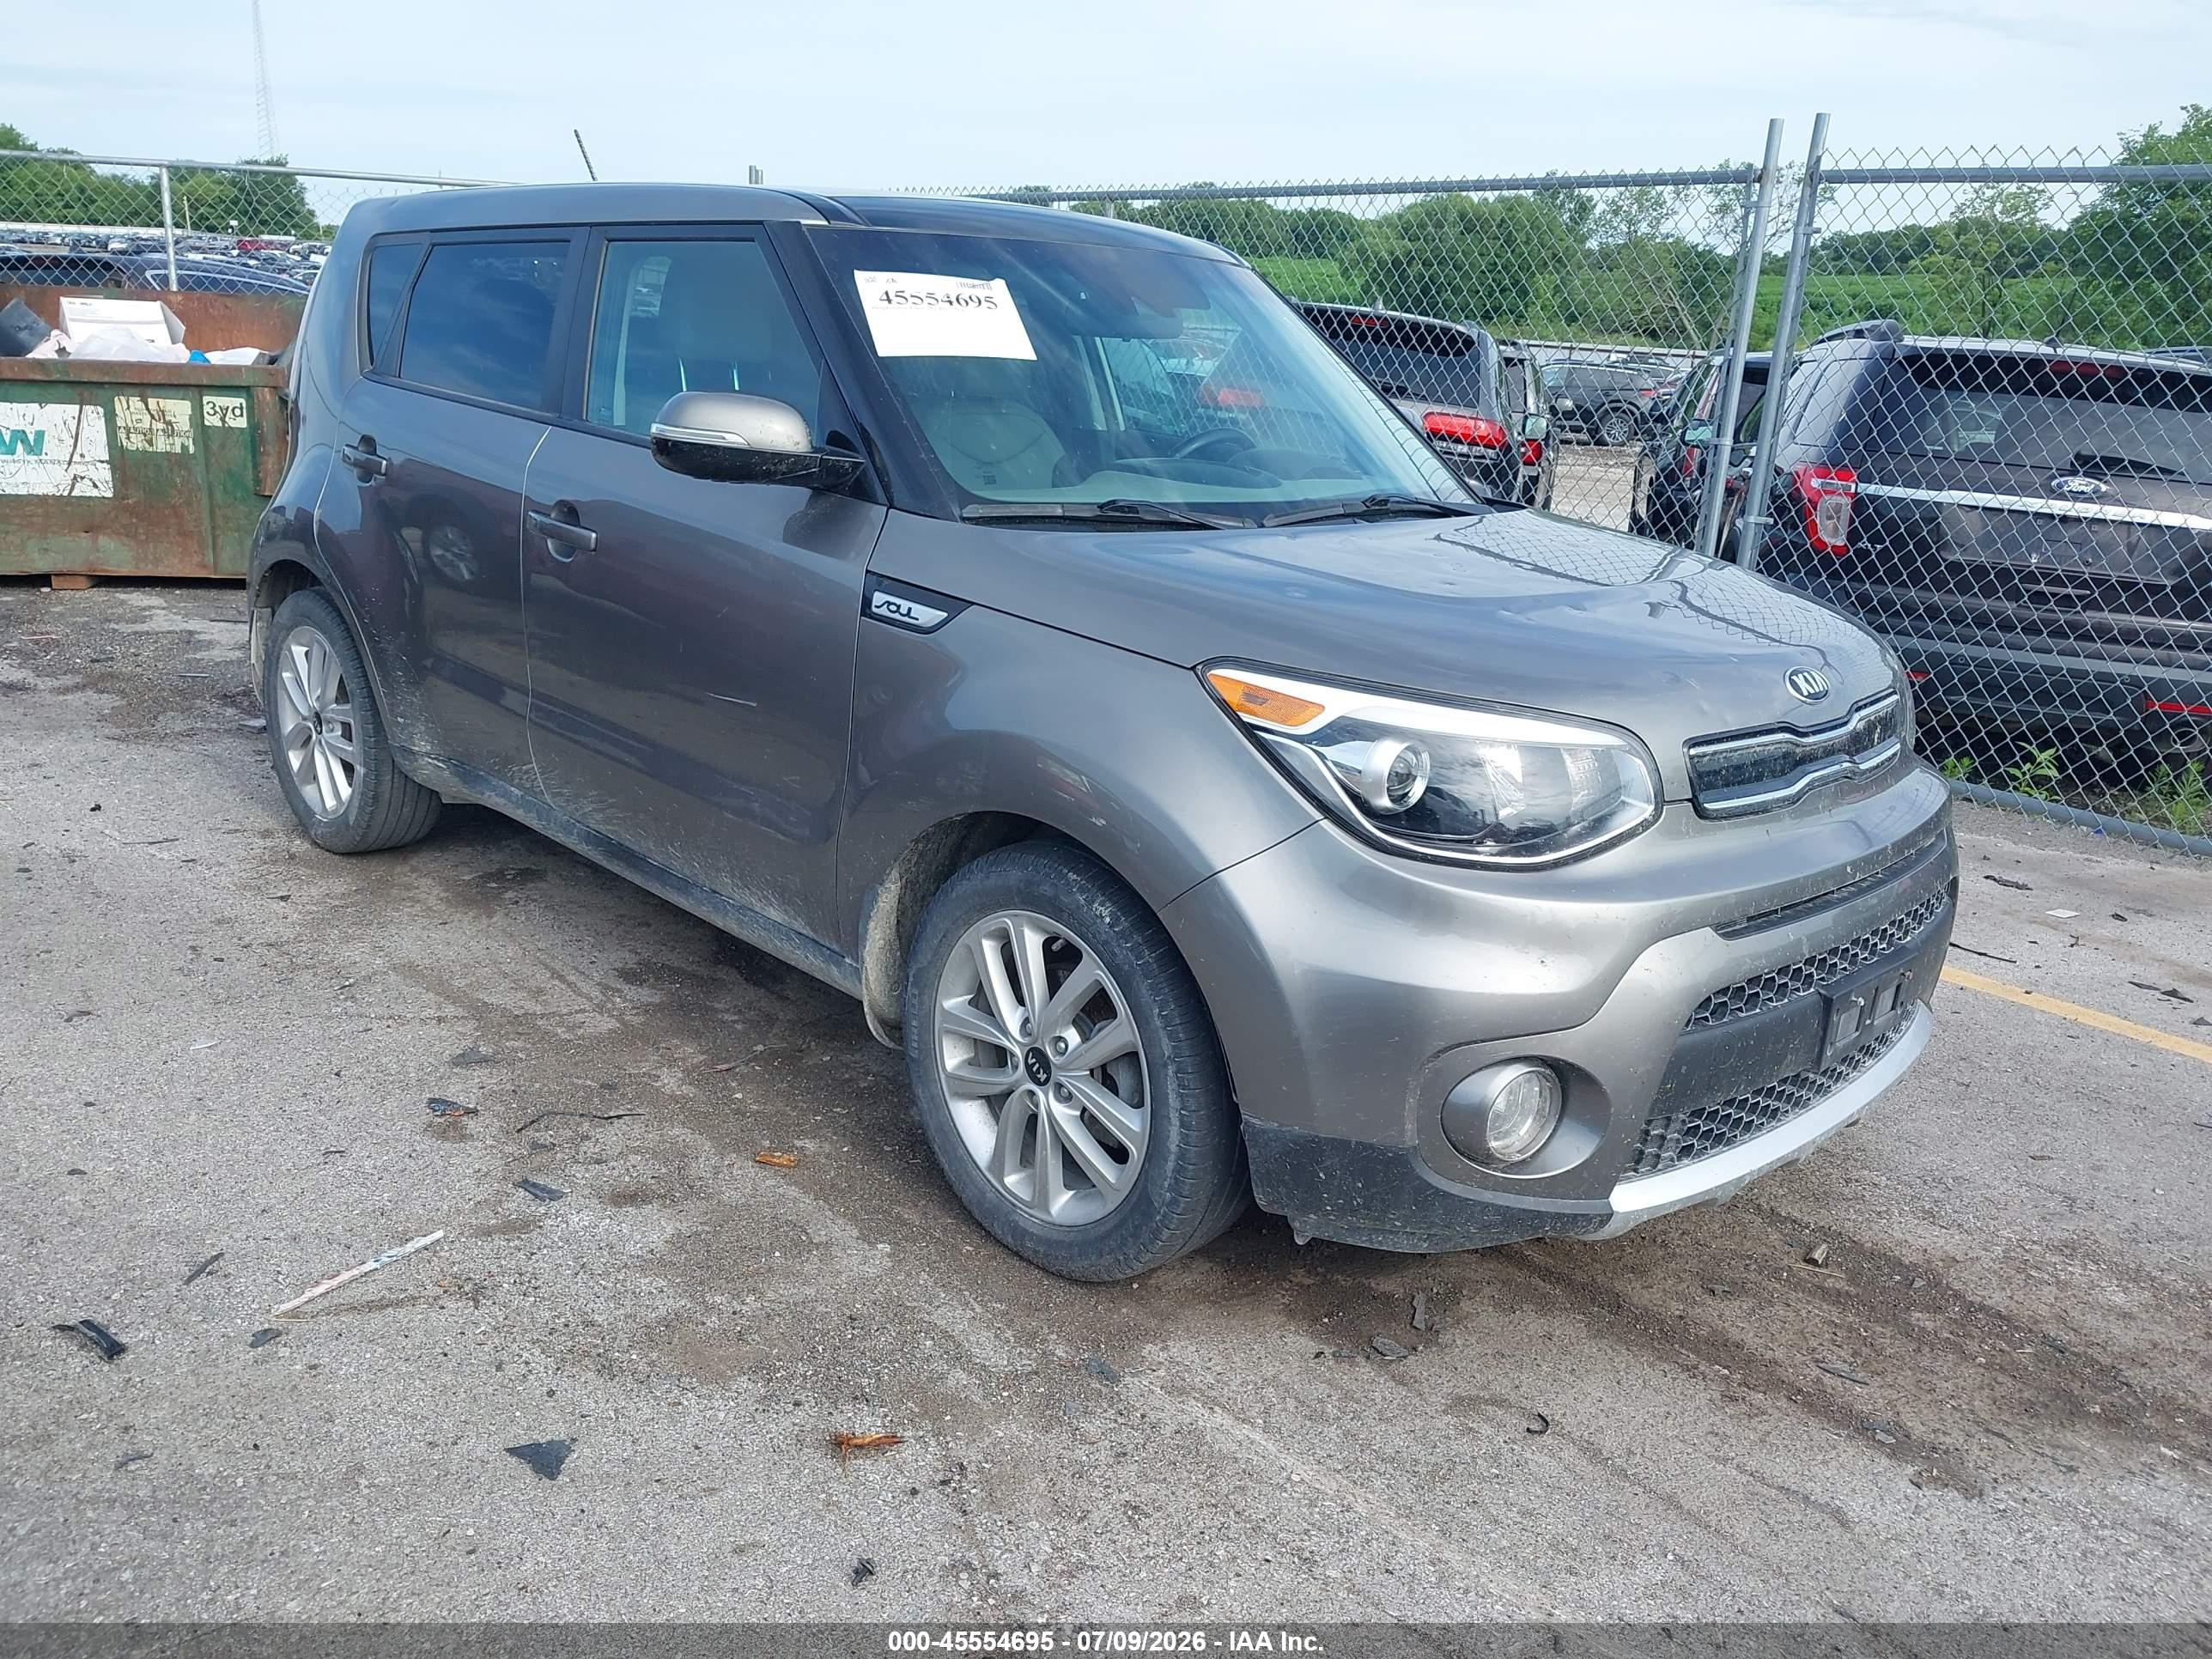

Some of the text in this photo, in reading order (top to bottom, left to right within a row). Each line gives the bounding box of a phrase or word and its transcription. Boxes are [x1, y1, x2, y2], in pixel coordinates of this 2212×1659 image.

[878, 290, 999, 311] 45554695
[205, 400, 245, 424] 3yd
[1790, 671, 1828, 696] KIA
[1027, 1051, 1048, 1083] KIA
